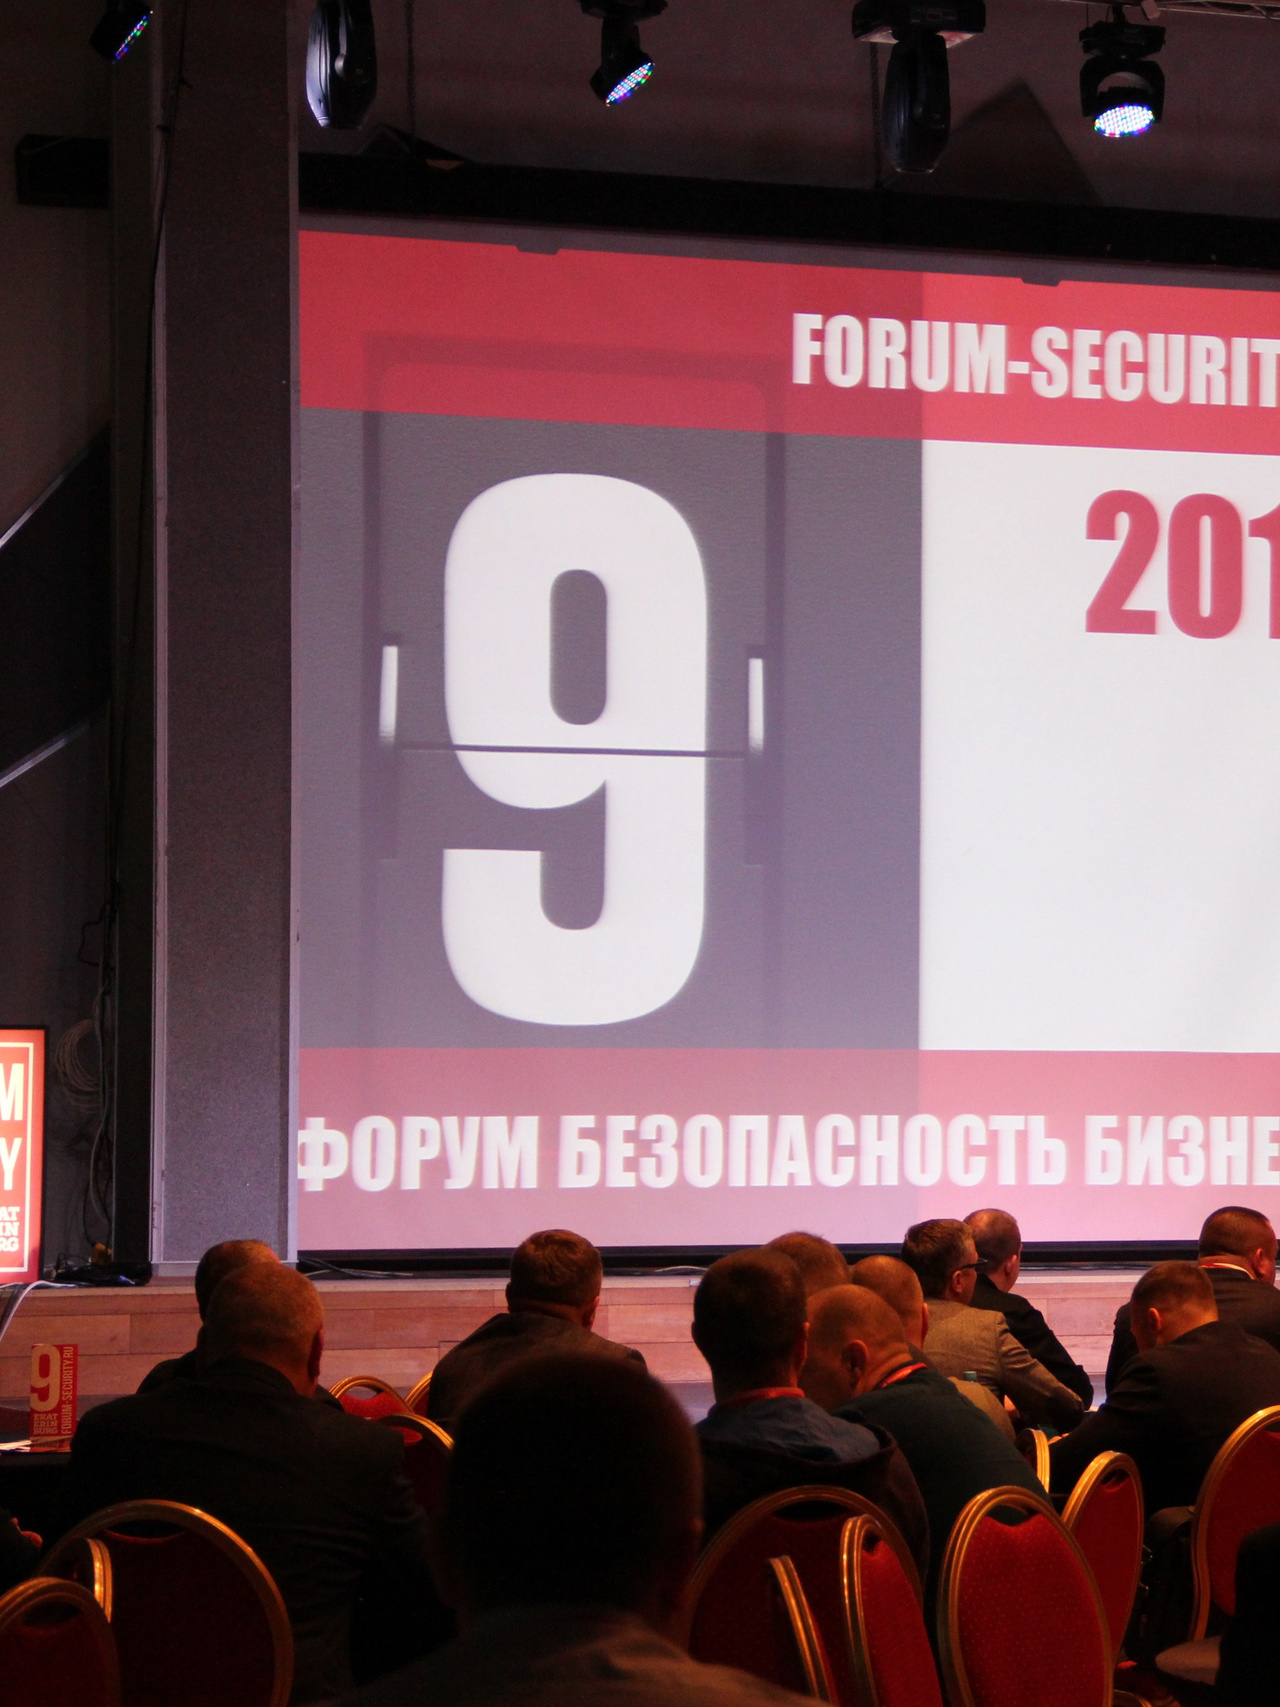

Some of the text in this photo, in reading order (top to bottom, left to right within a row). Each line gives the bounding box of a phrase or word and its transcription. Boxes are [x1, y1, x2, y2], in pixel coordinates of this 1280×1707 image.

[442, 472, 709, 1027] 9
[298, 1114, 540, 1193] ФОРУМ
[557, 1113, 1068, 1189] БЕЗОПАСНОСТЬ
[30, 1344, 61, 1412] 9
[33, 1427, 58, 1435] BURG
